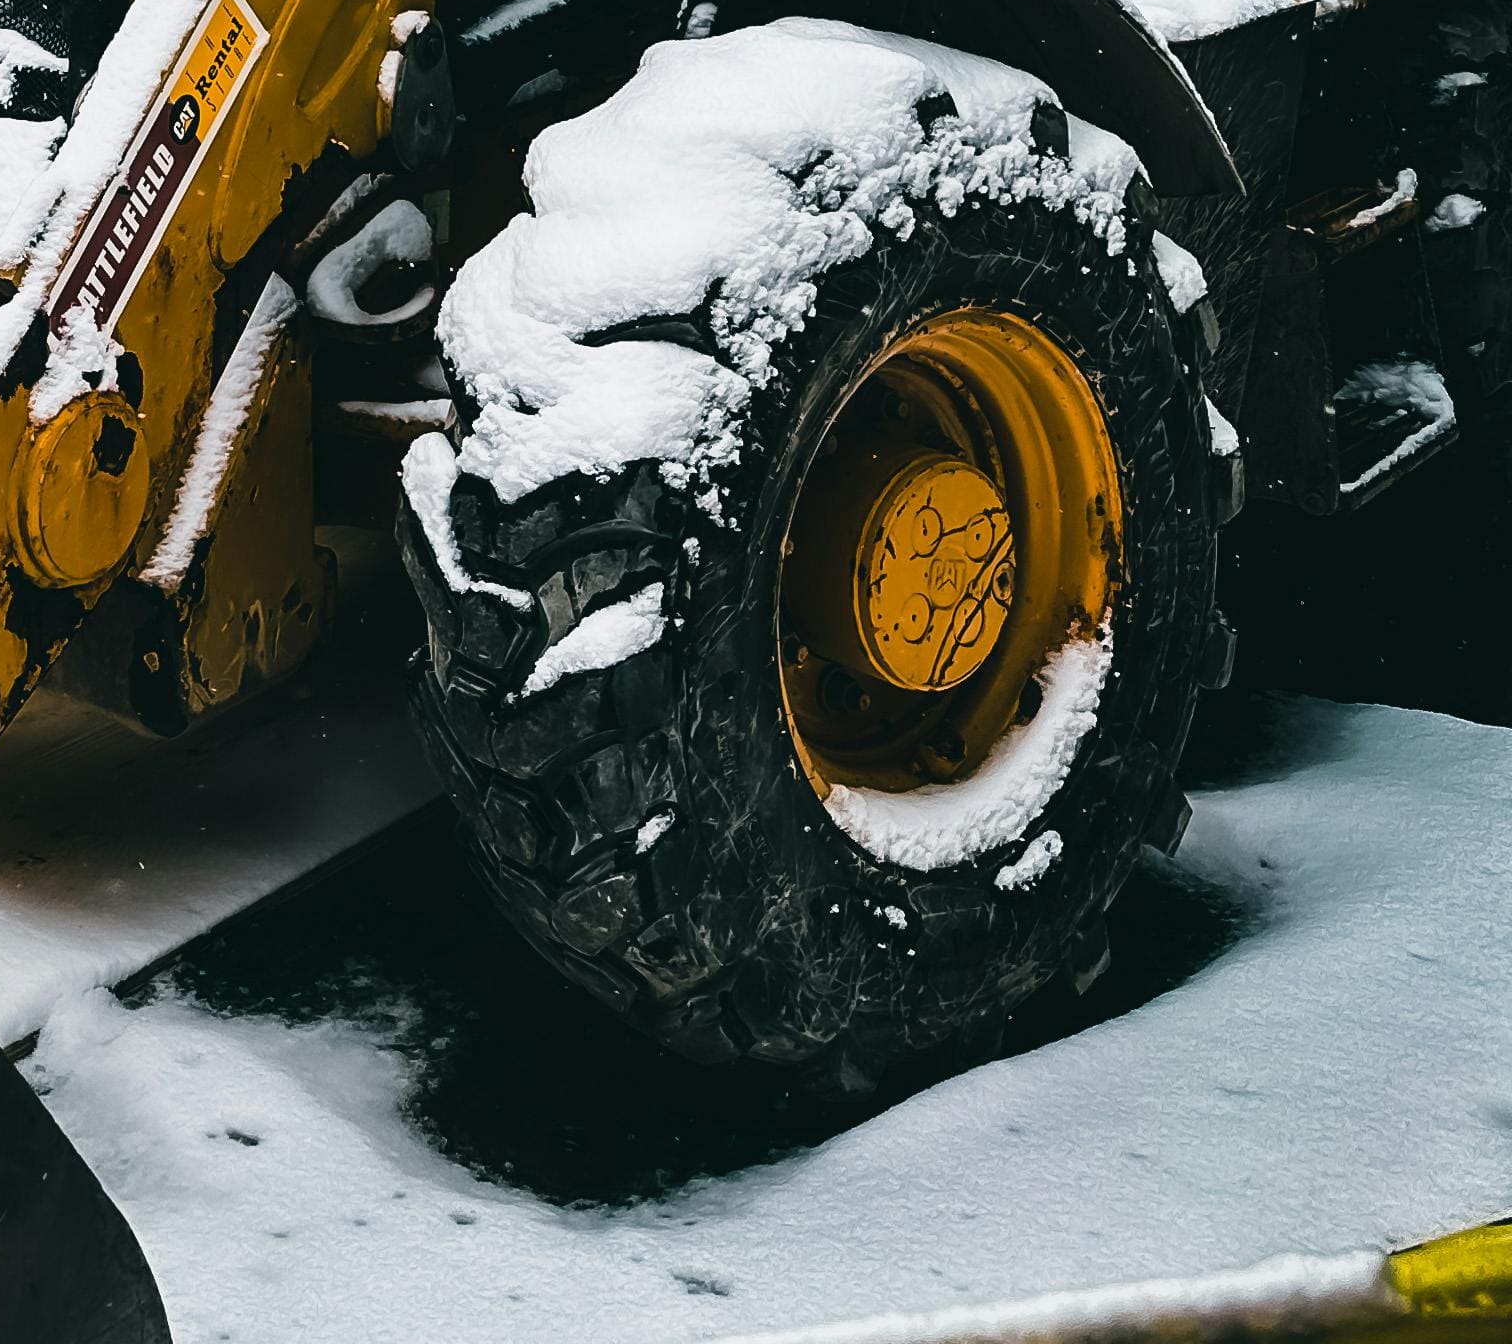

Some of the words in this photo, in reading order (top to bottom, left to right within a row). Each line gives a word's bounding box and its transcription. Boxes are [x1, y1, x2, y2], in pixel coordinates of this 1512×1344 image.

[195, 16, 243, 99] Rental
[173, 101, 196, 140] CAT
[76, 143, 175, 314] ATTLEFIELD
